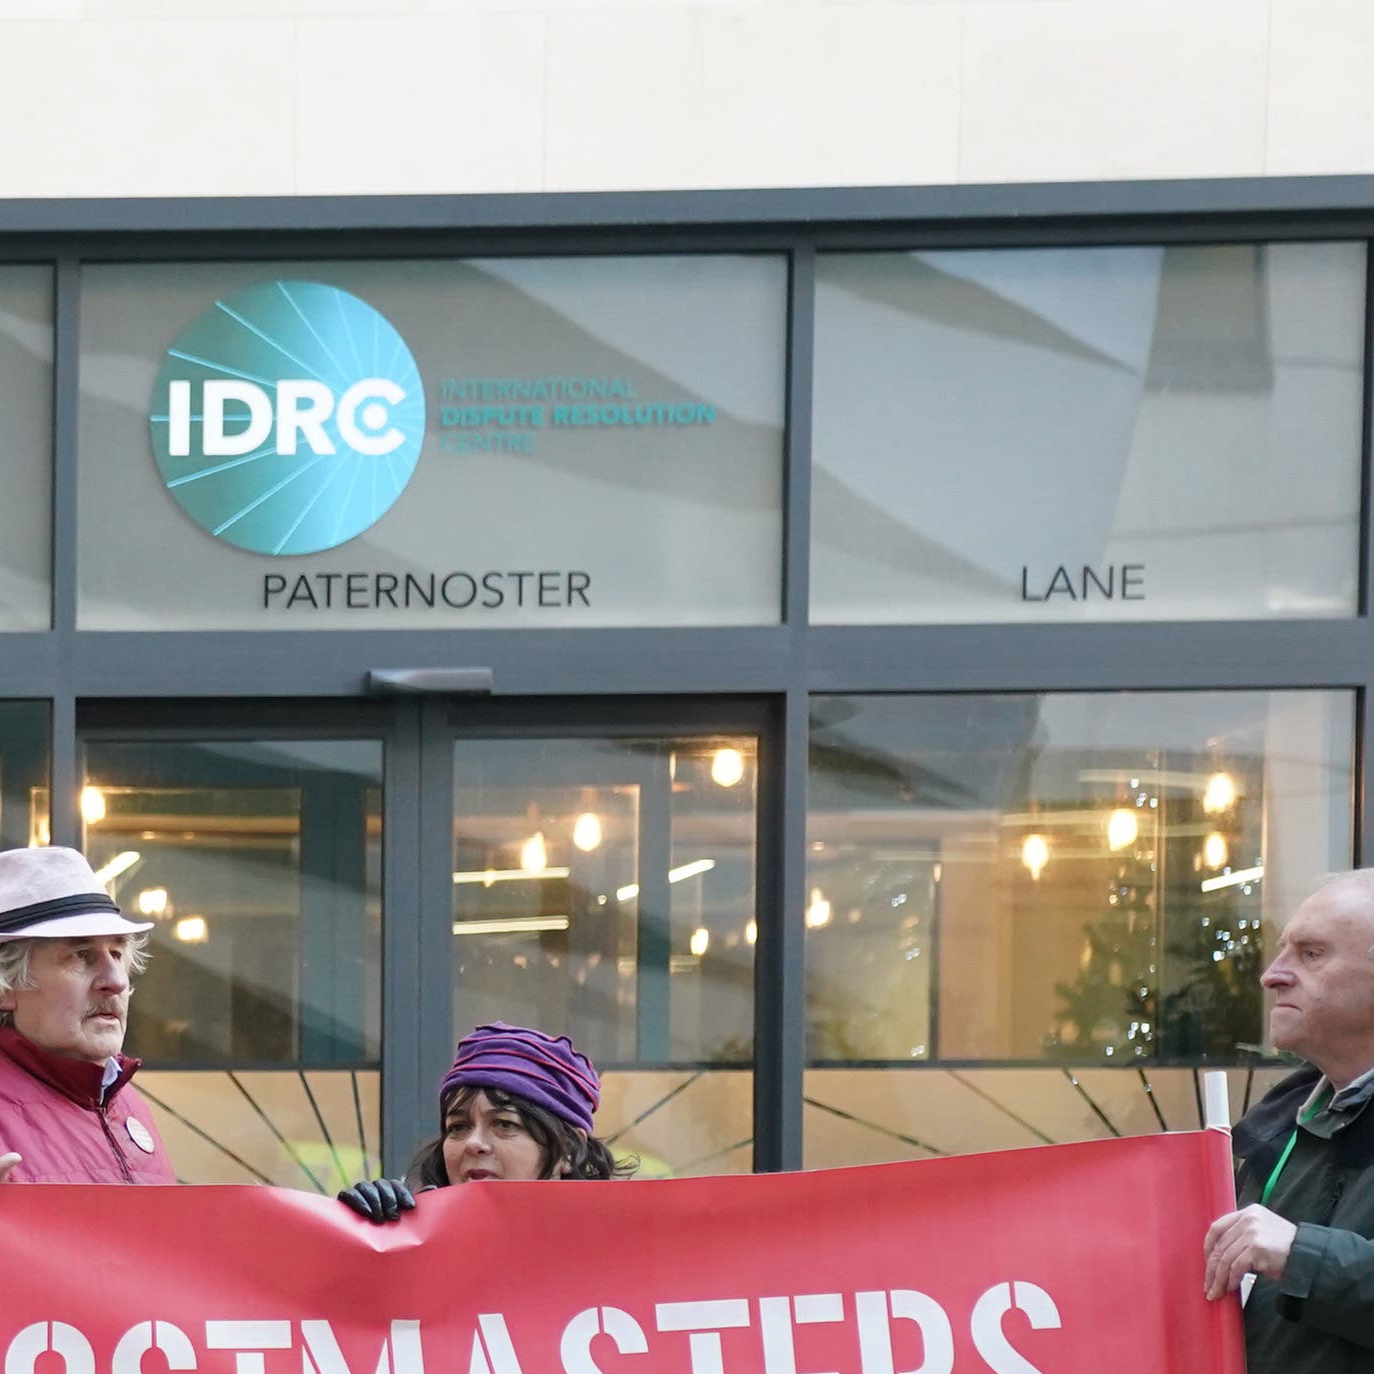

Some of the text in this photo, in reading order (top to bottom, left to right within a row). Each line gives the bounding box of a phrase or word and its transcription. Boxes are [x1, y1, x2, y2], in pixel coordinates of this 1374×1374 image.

[441, 379, 638, 401] INTERNATIONAL
[169, 378, 406, 456] IDRC
[441, 402, 718, 427] DISPUTE RESOLUTION
[263, 572, 592, 609] PATERNOSTER
[1022, 565, 1145, 601] LANE
